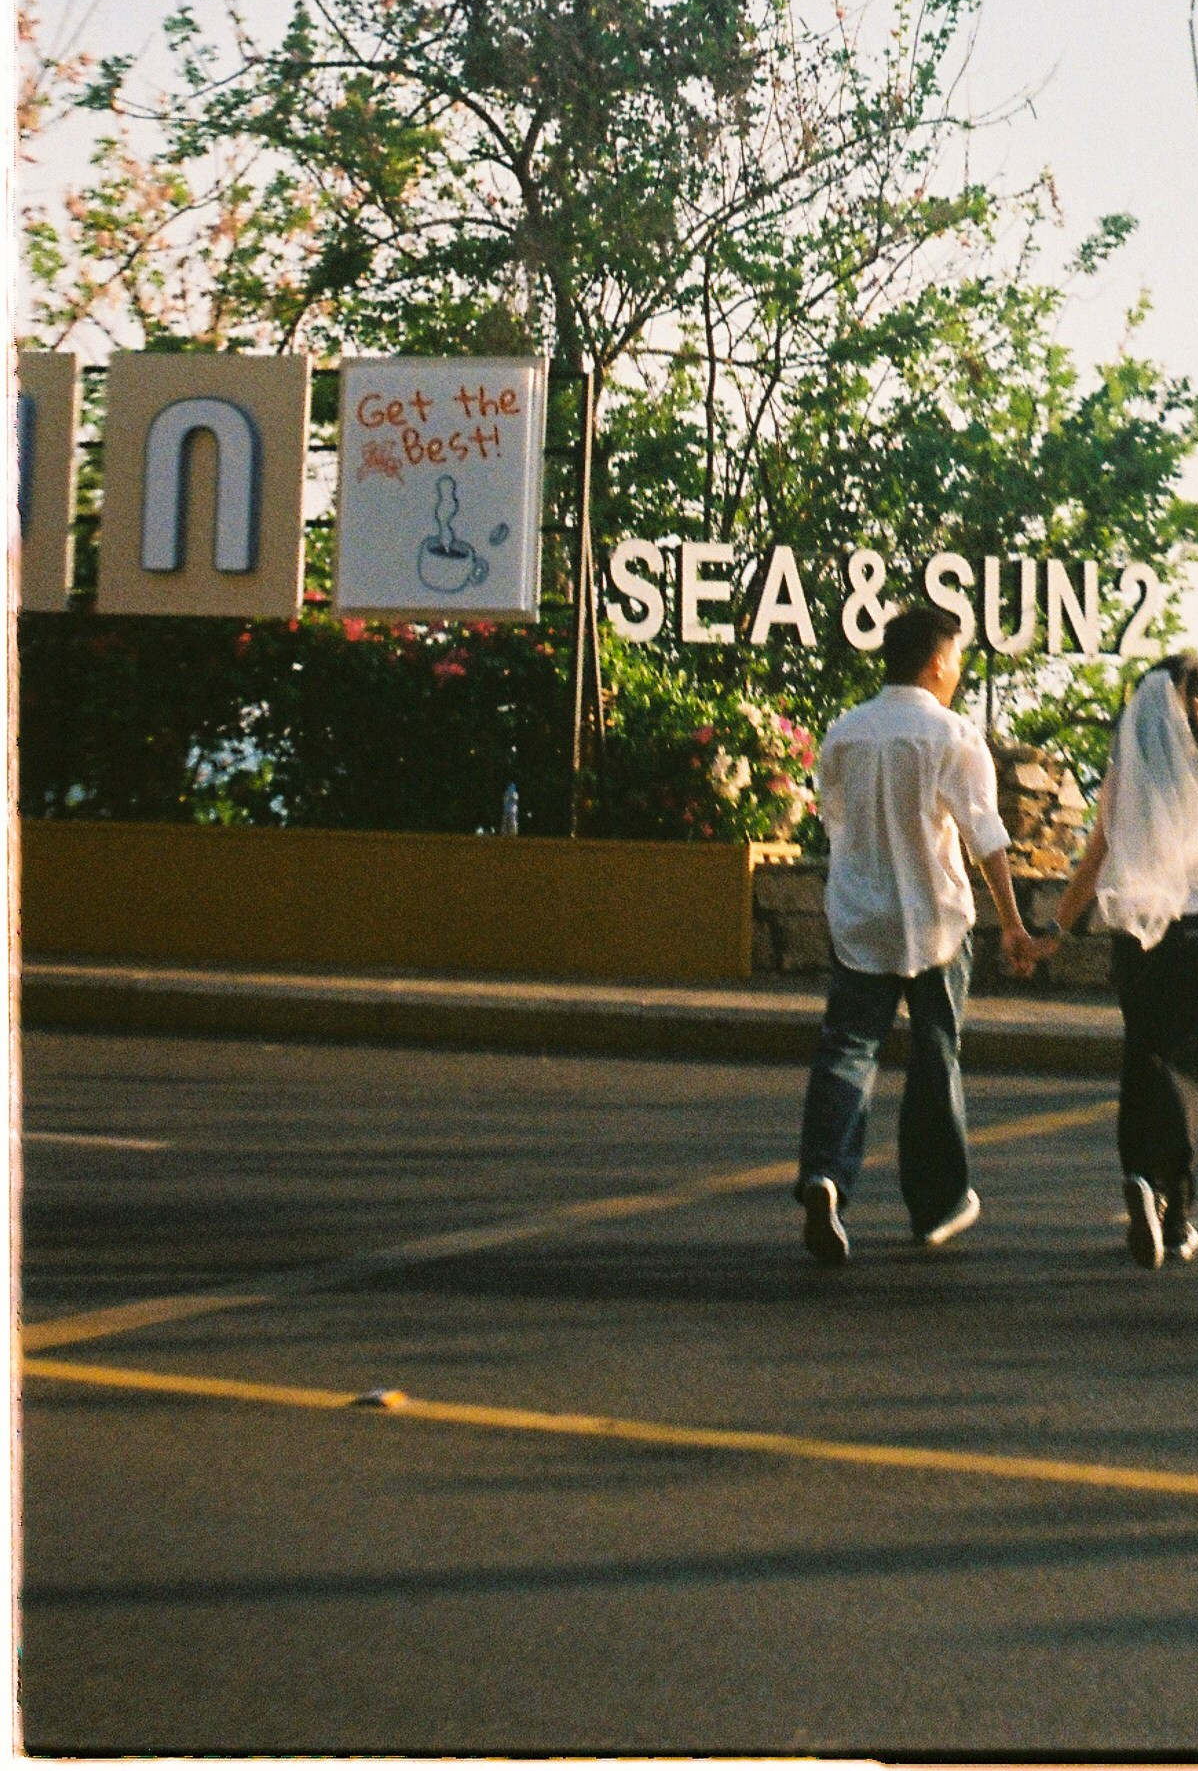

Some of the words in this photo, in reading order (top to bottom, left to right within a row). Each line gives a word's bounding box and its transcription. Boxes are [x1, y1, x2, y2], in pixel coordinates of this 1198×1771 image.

[356, 387, 433, 429] Get
[454, 384, 520, 419] the
[402, 425, 501, 465] Best!
[605, 537, 818, 646] SEA
[842, 548, 900, 650] &
[924, 551, 1100, 658] SUN
